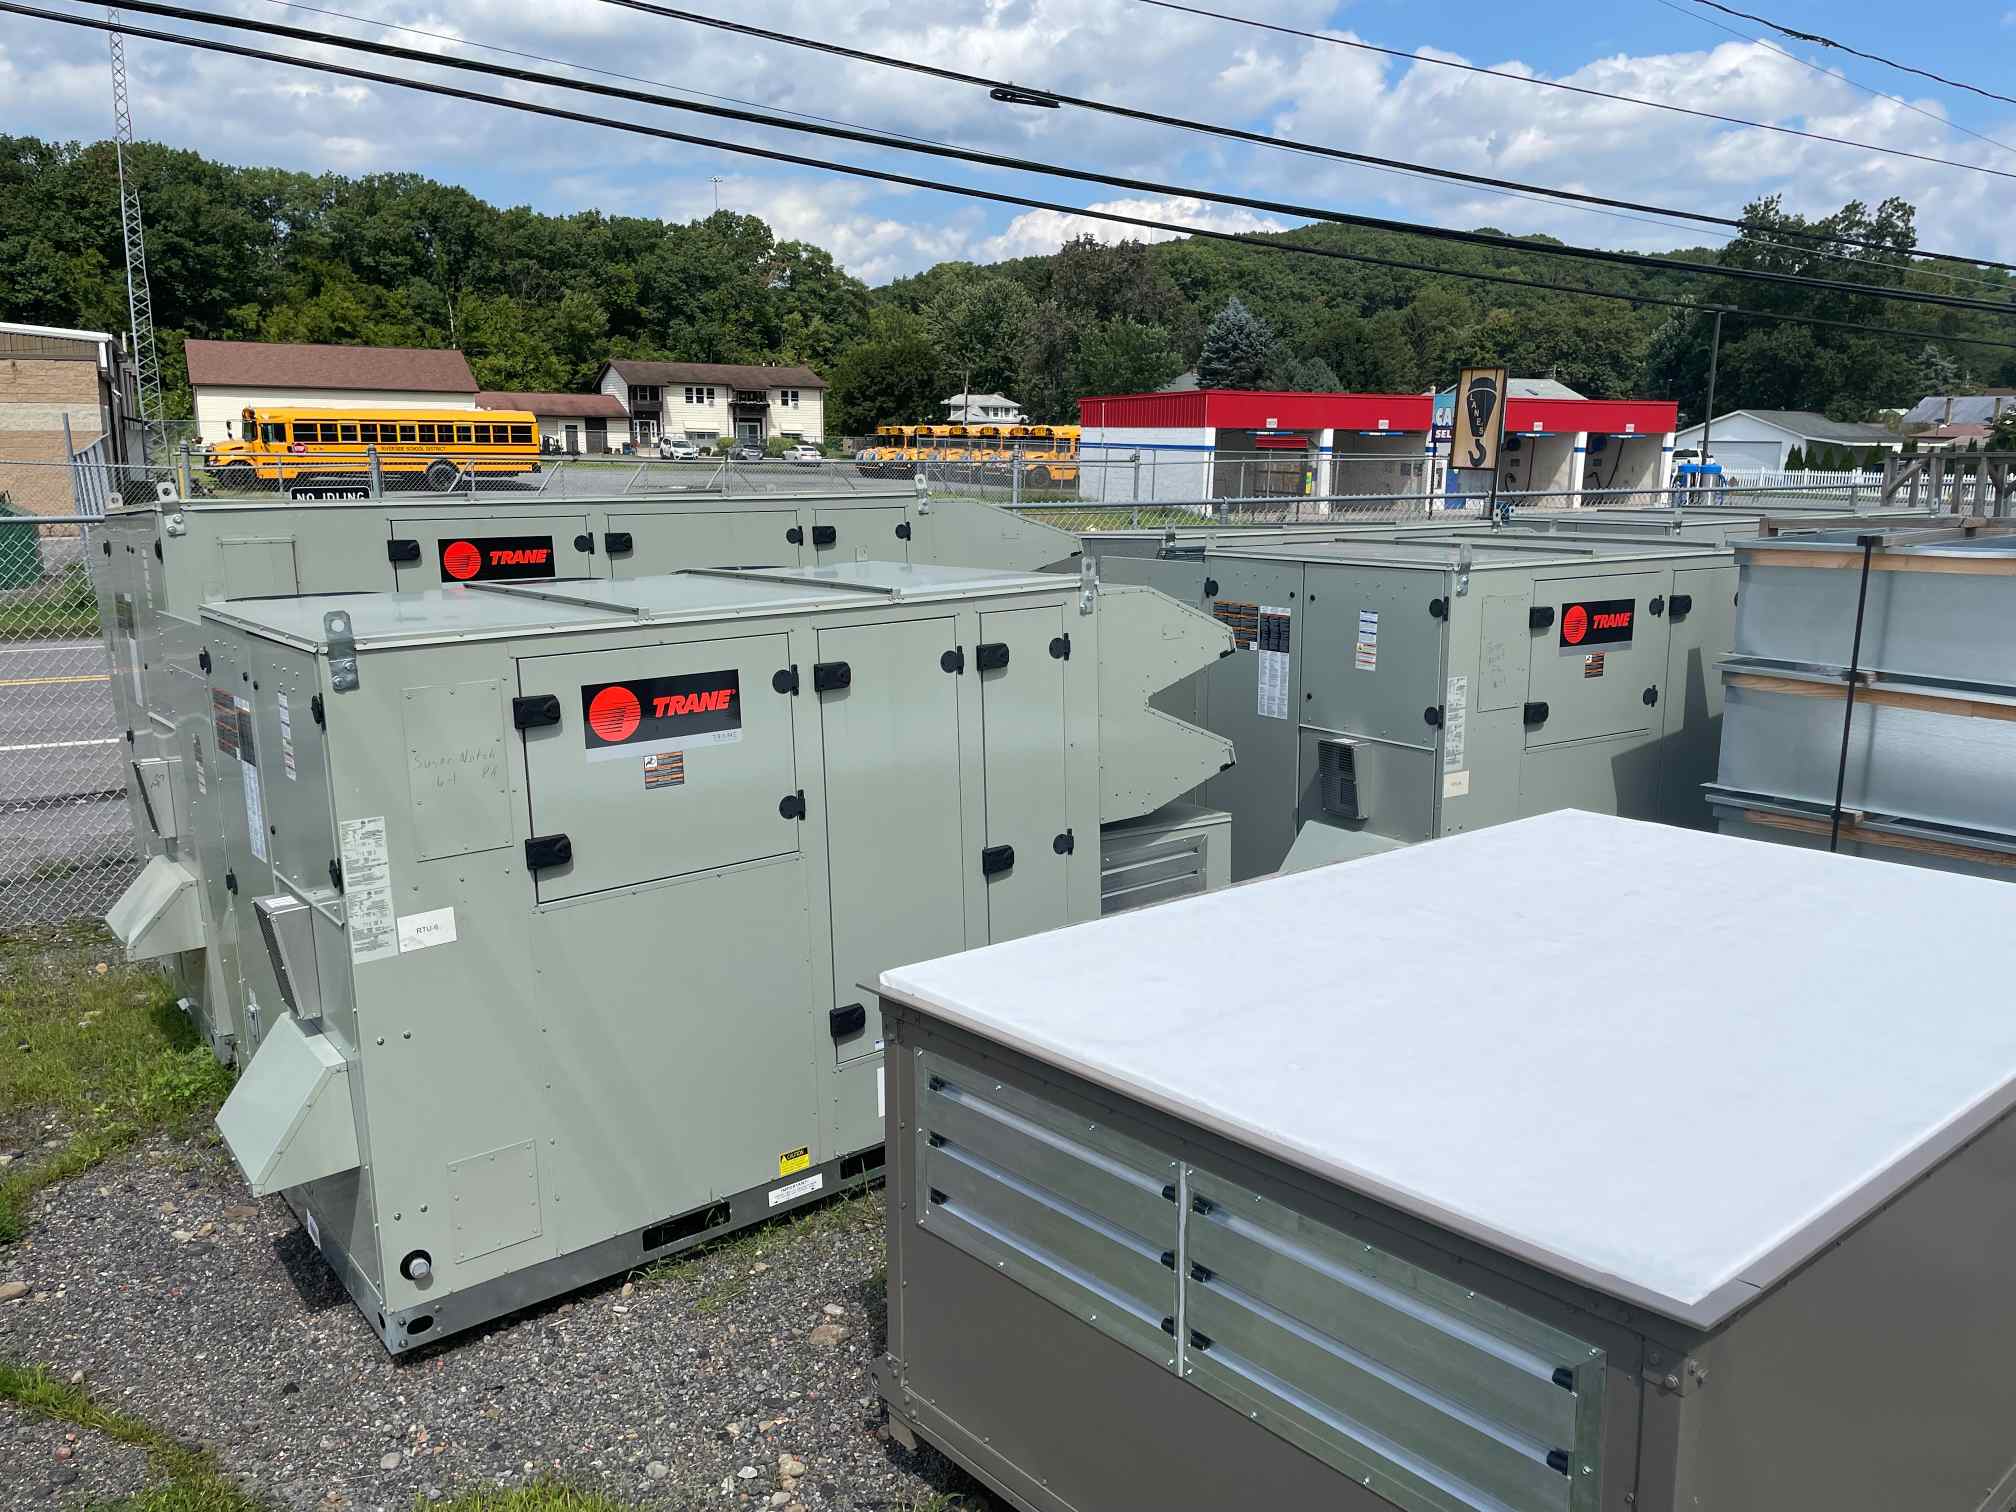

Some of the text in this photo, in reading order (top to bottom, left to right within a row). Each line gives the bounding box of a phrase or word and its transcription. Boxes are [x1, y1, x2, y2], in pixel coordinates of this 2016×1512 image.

[1435, 407, 1454, 426] CA
[1435, 430, 1452, 438] SEL
[296, 492, 364, 500] NO IDLING
[490, 549, 547, 565] TRANE
[1593, 613, 1631, 629] TRANE
[653, 689, 733, 718] TRANE
